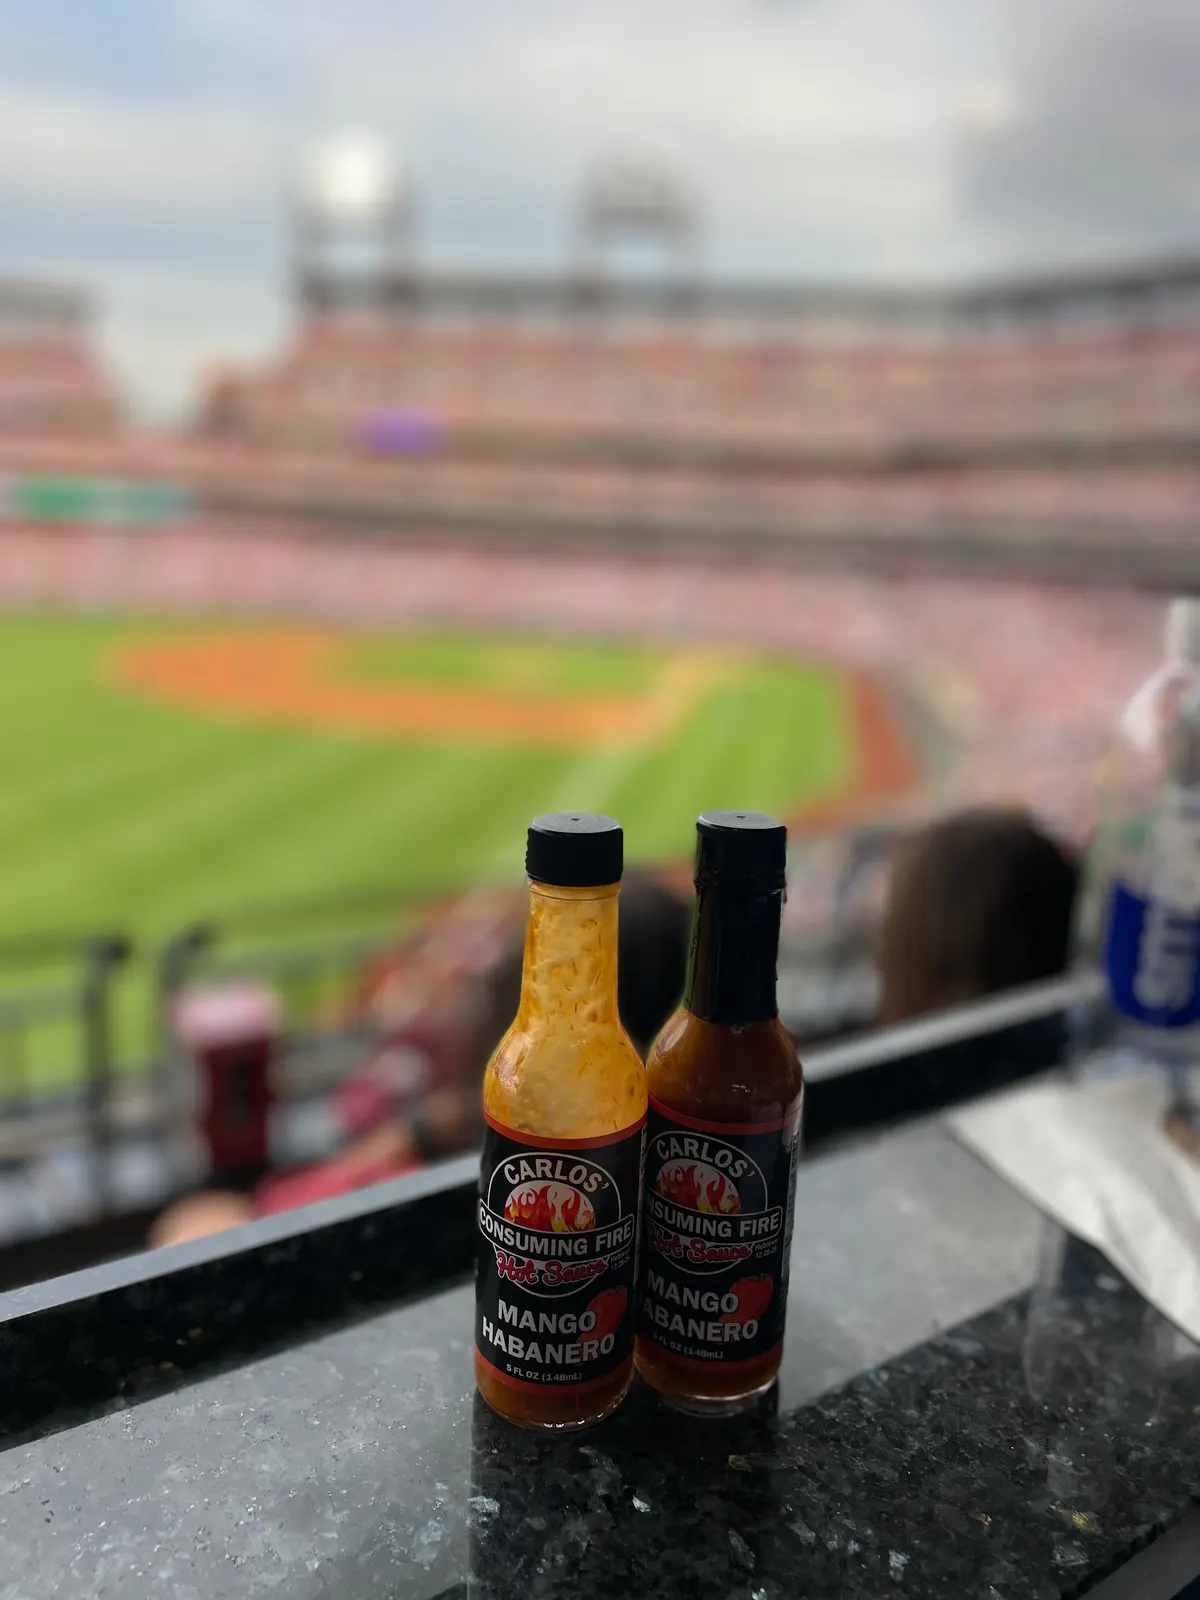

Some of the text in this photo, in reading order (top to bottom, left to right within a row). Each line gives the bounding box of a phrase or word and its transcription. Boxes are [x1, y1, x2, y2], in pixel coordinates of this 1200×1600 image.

[503, 1158, 610, 1193] CARLOS'
[656, 1137, 756, 1178] CARLOS'
[480, 1206, 632, 1256] CONSUMING FIRE
[646, 1194, 780, 1238] NSUMING FIRE
[495, 1250, 609, 1286] Hot Sauce
[686, 1237, 754, 1264] Sauce
[647, 1268, 739, 1314] MANGO
[497, 1298, 597, 1335] MANGO
[642, 1296, 759, 1342] ABANERO
[482, 1315, 615, 1365] HABANERO
[506, 1363, 583, 1383] 5 FL OZ (148mL)
